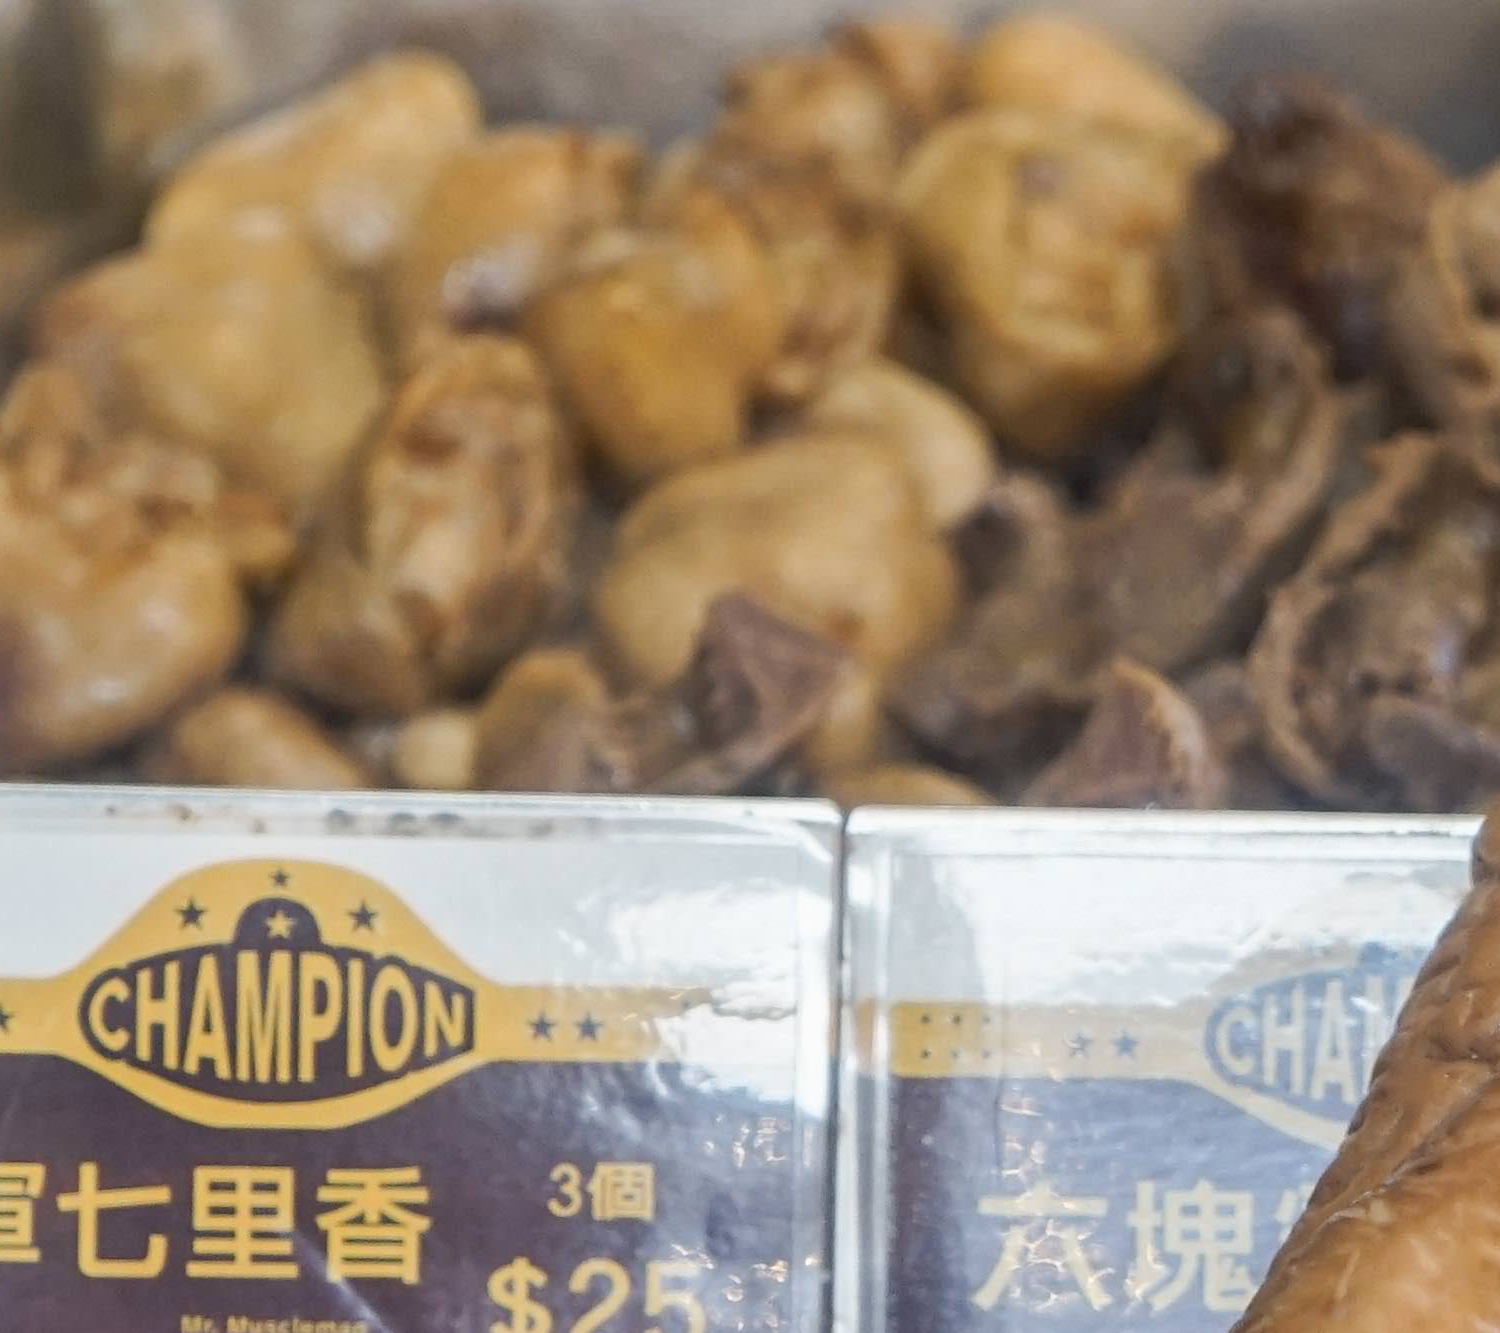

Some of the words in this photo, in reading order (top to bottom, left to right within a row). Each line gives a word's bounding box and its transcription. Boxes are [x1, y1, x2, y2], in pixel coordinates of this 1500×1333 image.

[88, 950, 468, 1086] CHAMPION
[547, 1162, 655, 1222] 3個
[971, 1178, 1316, 1315] 六塊
